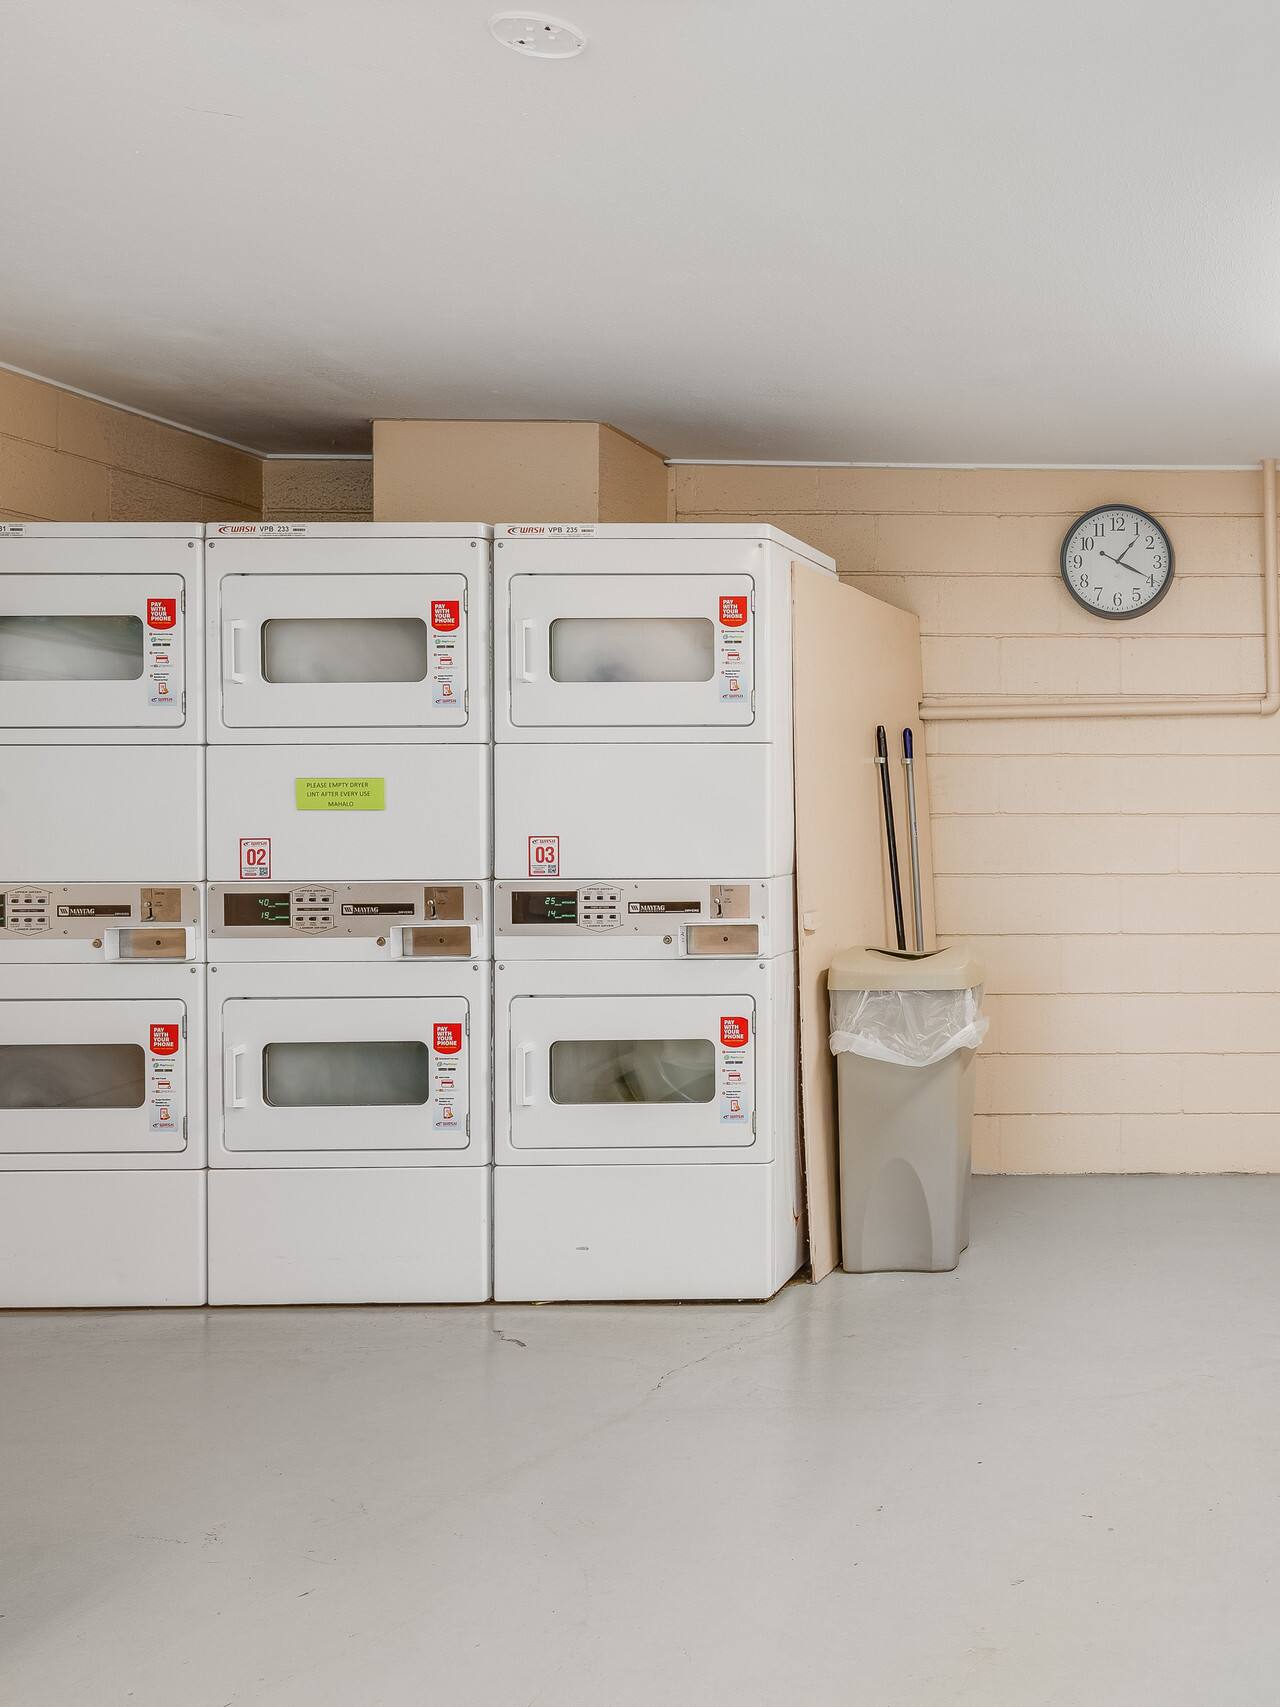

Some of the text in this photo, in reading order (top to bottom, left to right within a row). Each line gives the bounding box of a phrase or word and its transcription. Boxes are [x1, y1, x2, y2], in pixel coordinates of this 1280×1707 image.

[1093, 523, 1105, 538] 11
[1109, 517, 1126, 532] 12
[1133, 521, 1139, 536] 1
[1080, 536, 1095, 551] 10
[1145, 535, 1155, 550] 2
[1073, 554, 1083, 569] 9
[1152, 554, 1162, 569] 3
[1079, 573, 1089, 588] 8
[1145, 573, 1155, 588] 4
[1093, 586, 1103, 602] 7
[1113, 592, 1123, 607] 6
[1132, 587, 1141, 602] 5
[247, 848, 266, 865] 02
[536, 847, 554, 863] 03
[545, 897, 556, 905] 25
